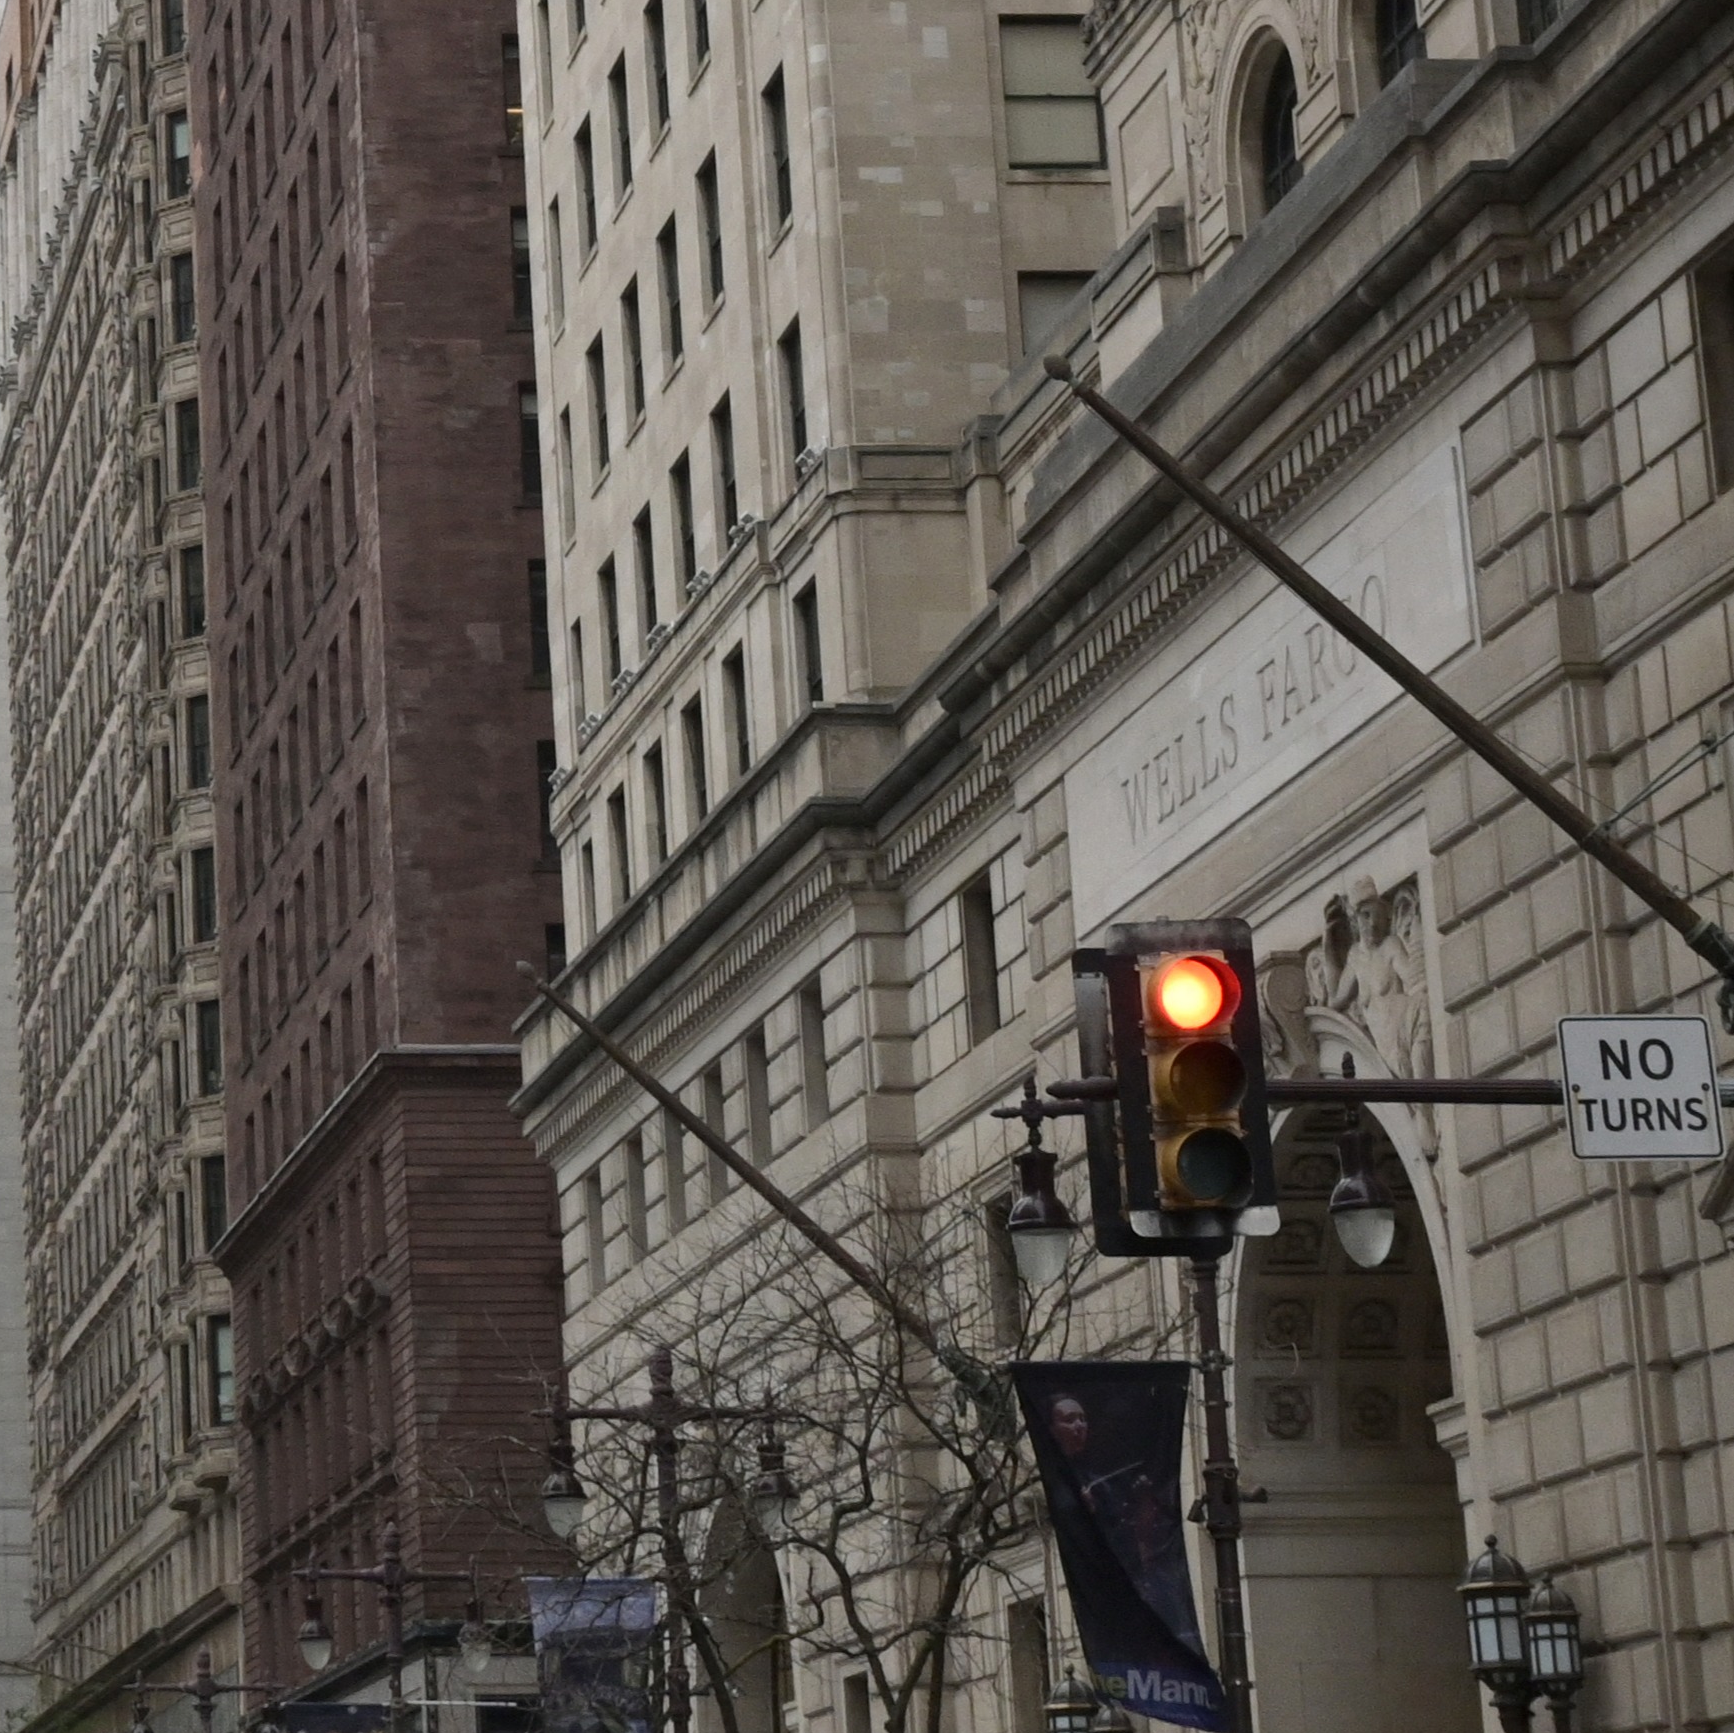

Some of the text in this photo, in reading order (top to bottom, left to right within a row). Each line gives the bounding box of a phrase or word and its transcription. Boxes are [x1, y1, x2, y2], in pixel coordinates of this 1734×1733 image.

[1120, 692, 1239, 846] WELLS
[1599, 1038, 1674, 1081] NO
[1578, 1097, 1708, 1132] TURNS
